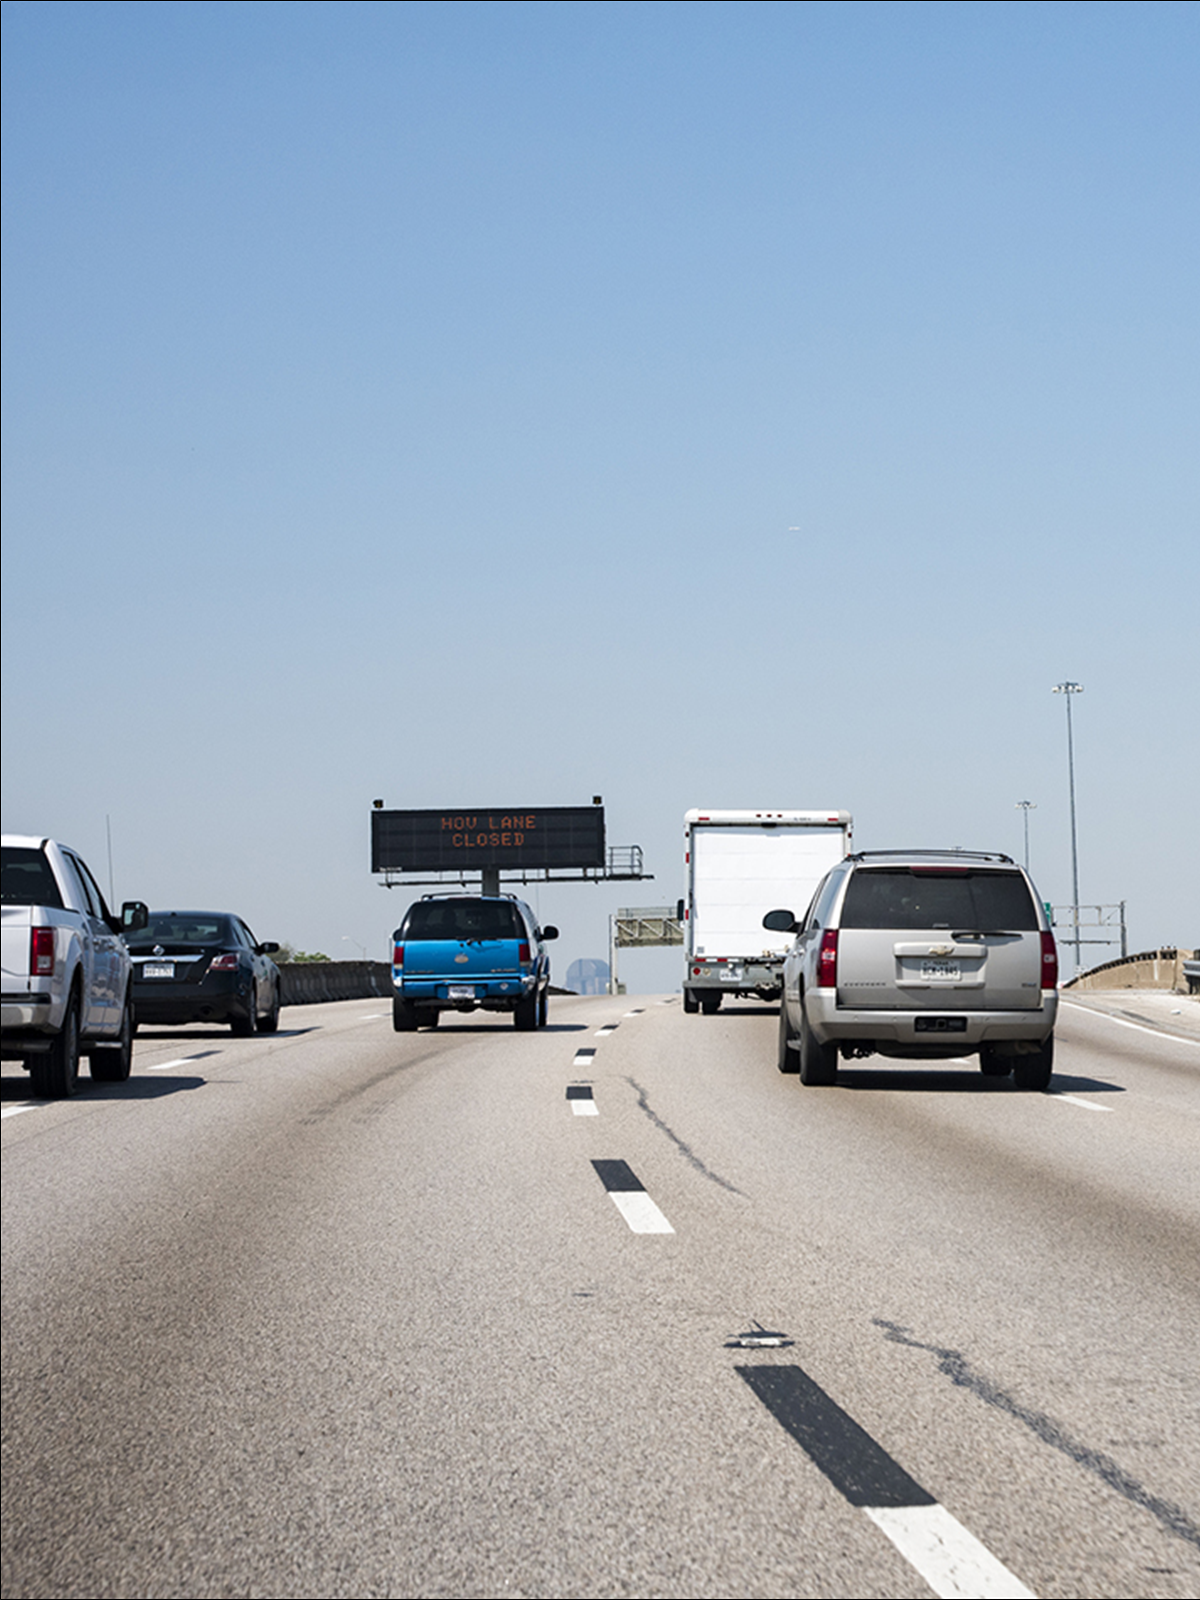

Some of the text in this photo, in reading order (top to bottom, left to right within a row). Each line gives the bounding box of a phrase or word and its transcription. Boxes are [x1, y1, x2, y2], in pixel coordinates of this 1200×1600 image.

[441, 814, 536, 830] HOV LANE
[452, 832, 525, 848] CLOSED
